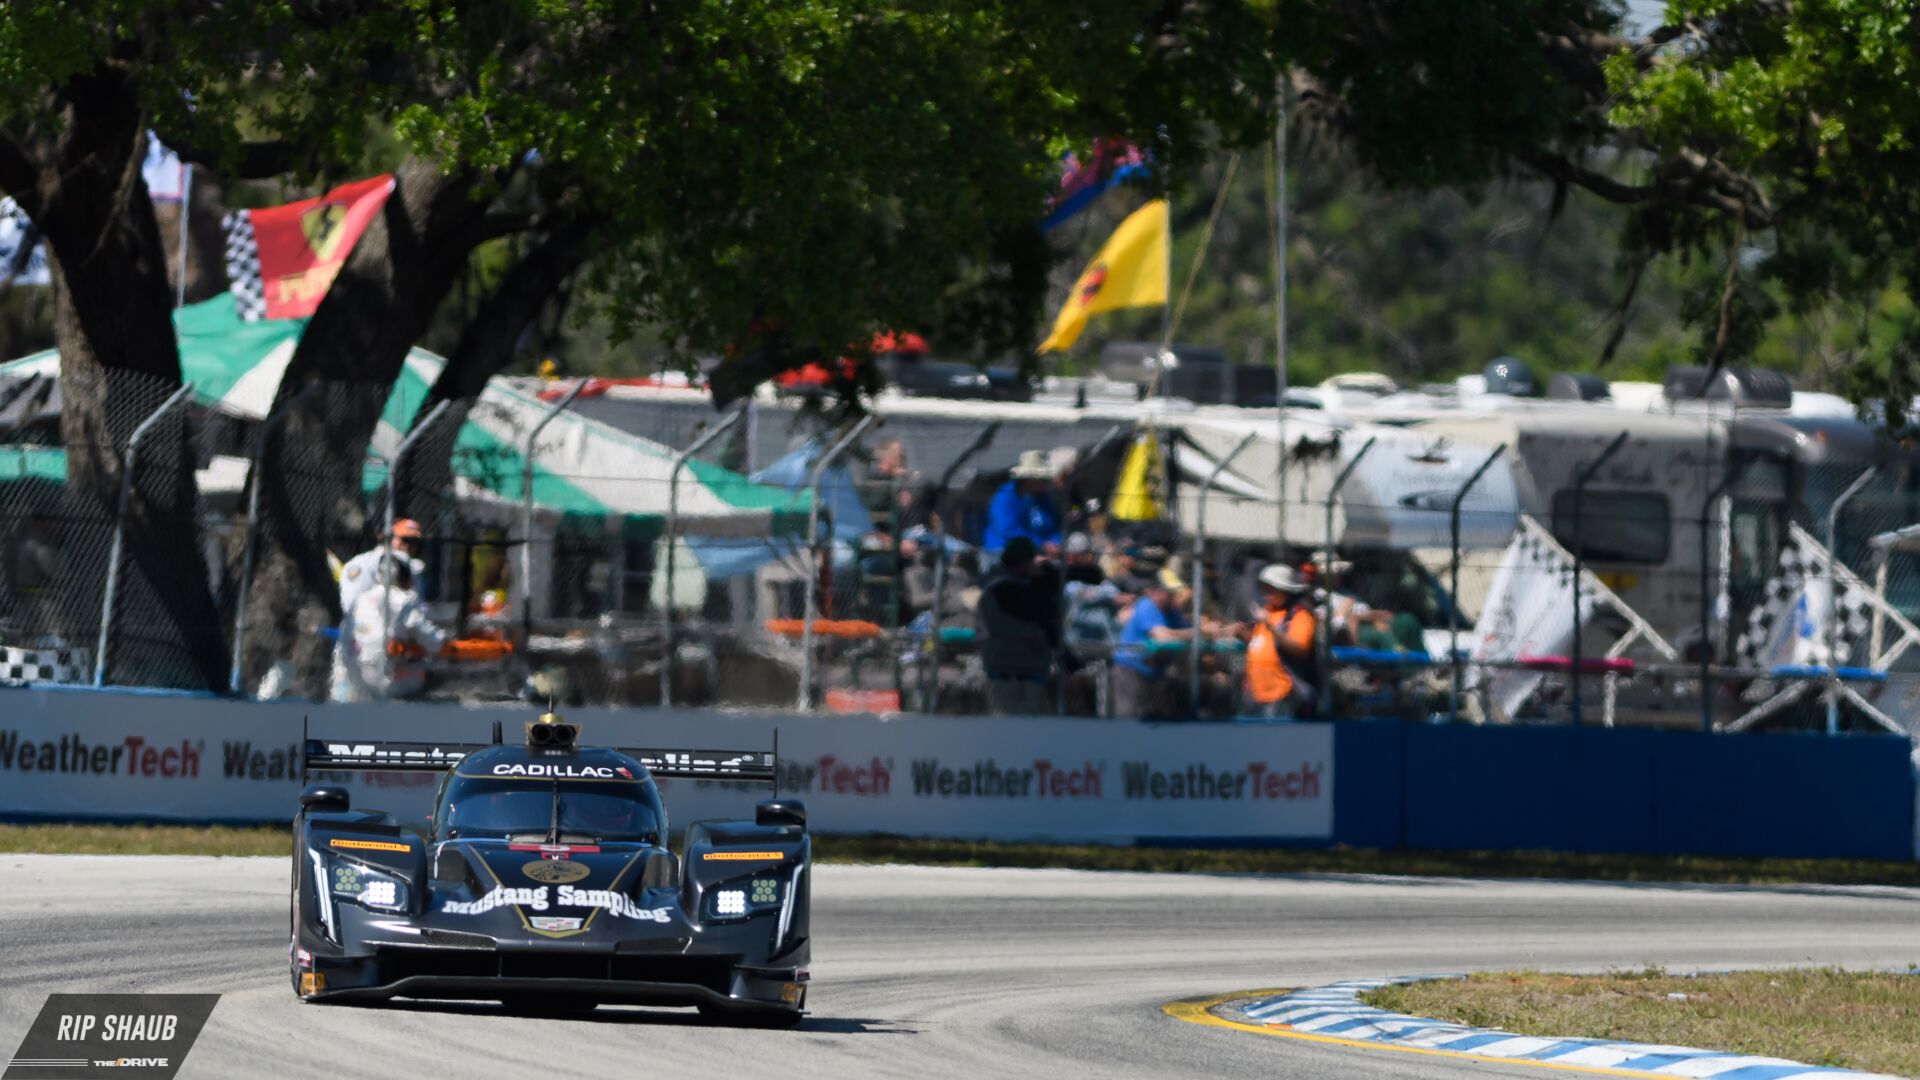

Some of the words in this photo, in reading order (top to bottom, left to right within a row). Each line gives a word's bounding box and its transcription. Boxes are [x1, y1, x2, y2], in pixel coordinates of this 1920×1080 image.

[0, 730, 201, 778] WeatherTech
[493, 764, 614, 778] CADILLAC
[911, 759, 1101, 798] WeatherTech
[1122, 761, 1320, 799] WeatherTech
[441, 885, 549, 915] Mustang
[557, 885, 675, 923] Sampling
